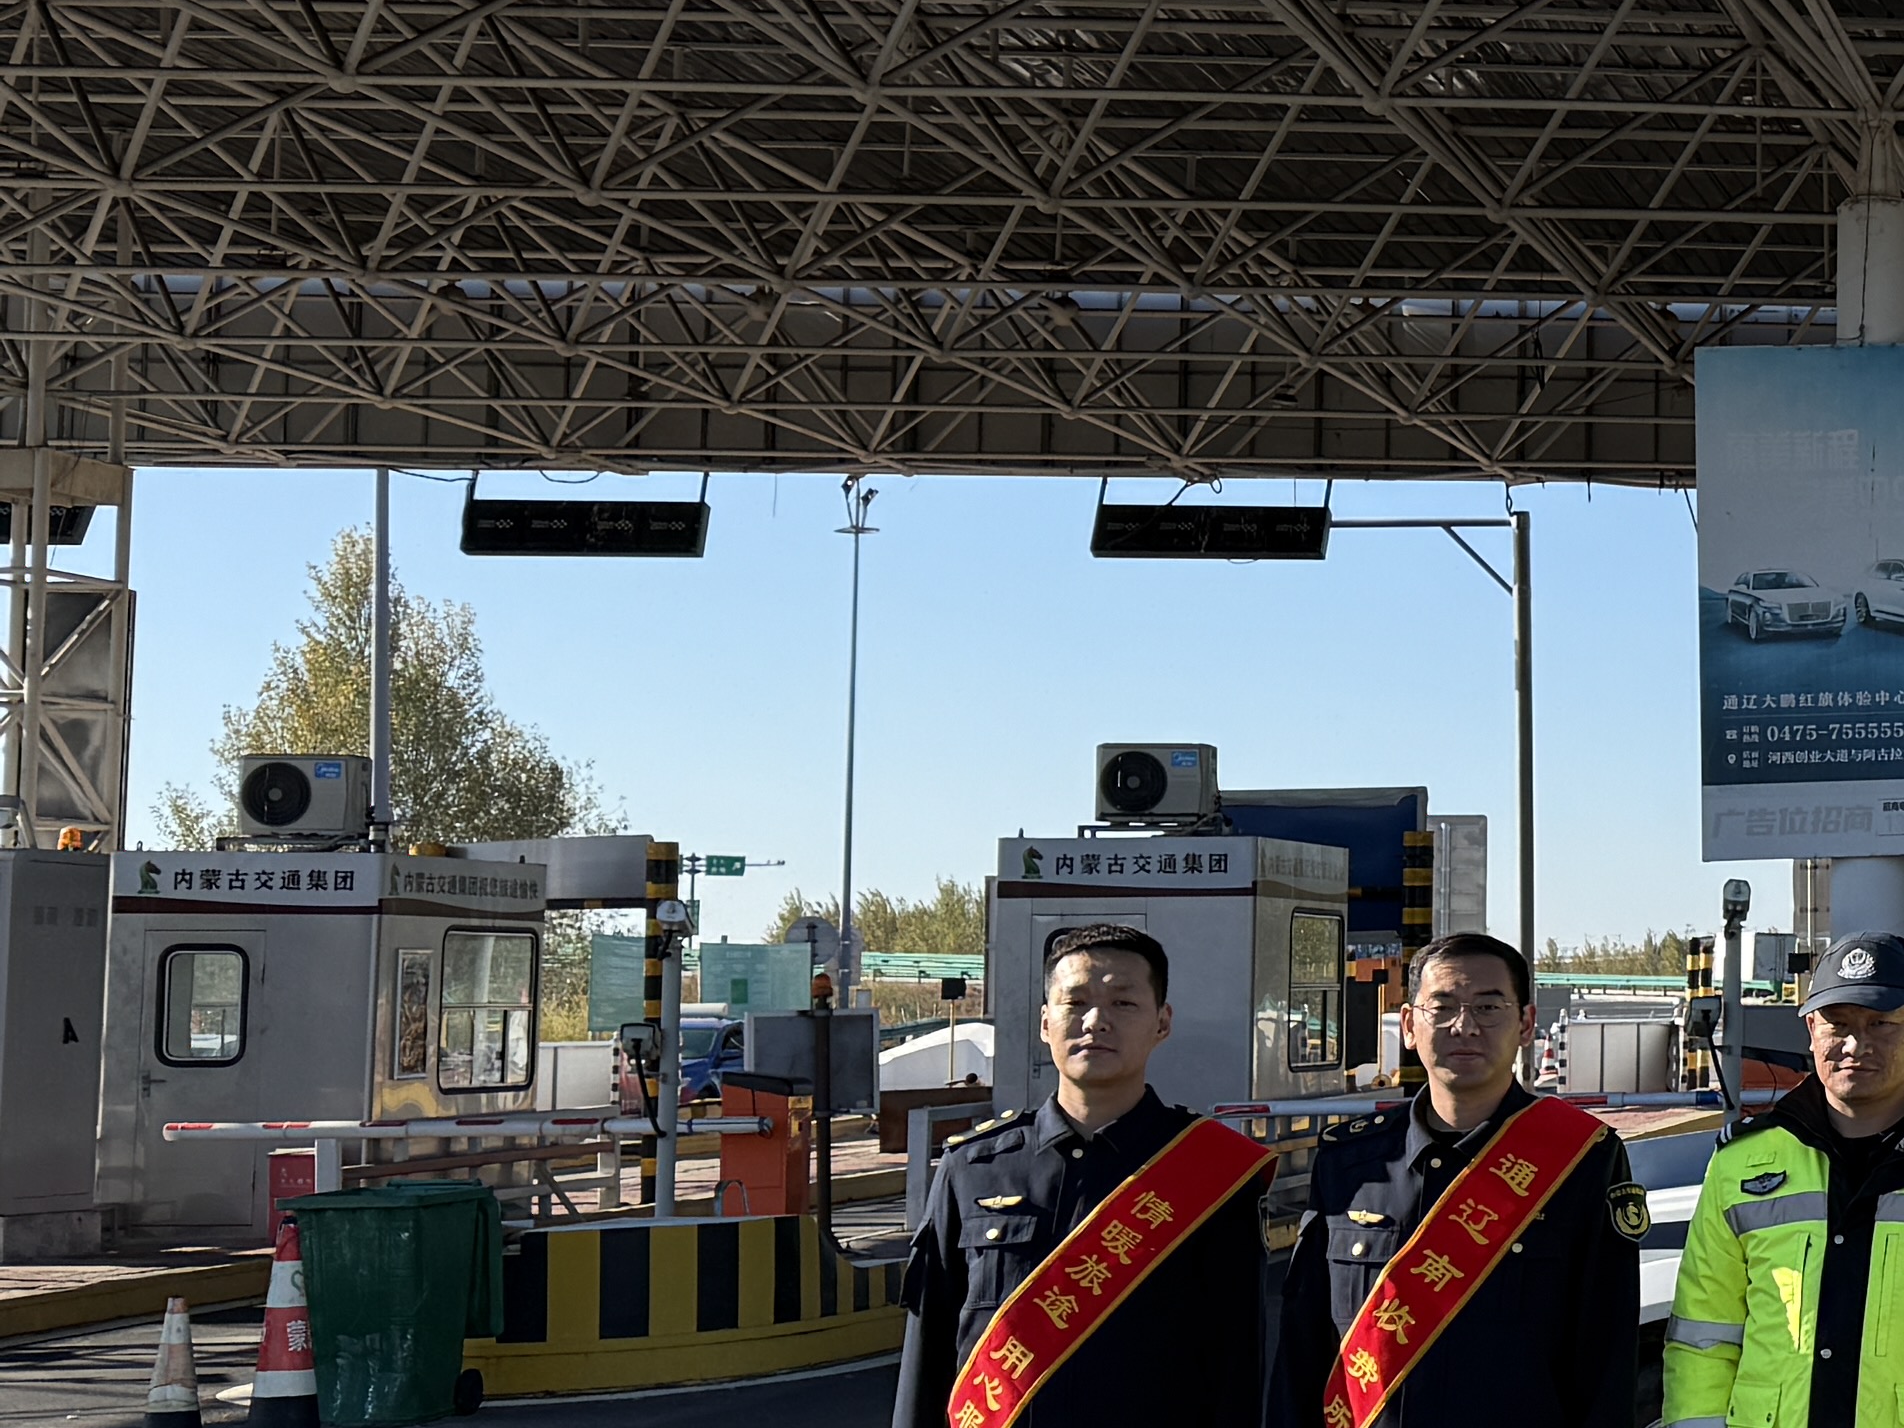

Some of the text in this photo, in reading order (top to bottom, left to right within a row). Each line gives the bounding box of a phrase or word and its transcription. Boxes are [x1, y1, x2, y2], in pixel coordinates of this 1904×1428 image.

[1055, 853, 1229, 876] 内蒙古交通集团
[173, 868, 355, 892] 内蒙古交通集团
[1033, 1190, 1175, 1330] 情暖旅途
